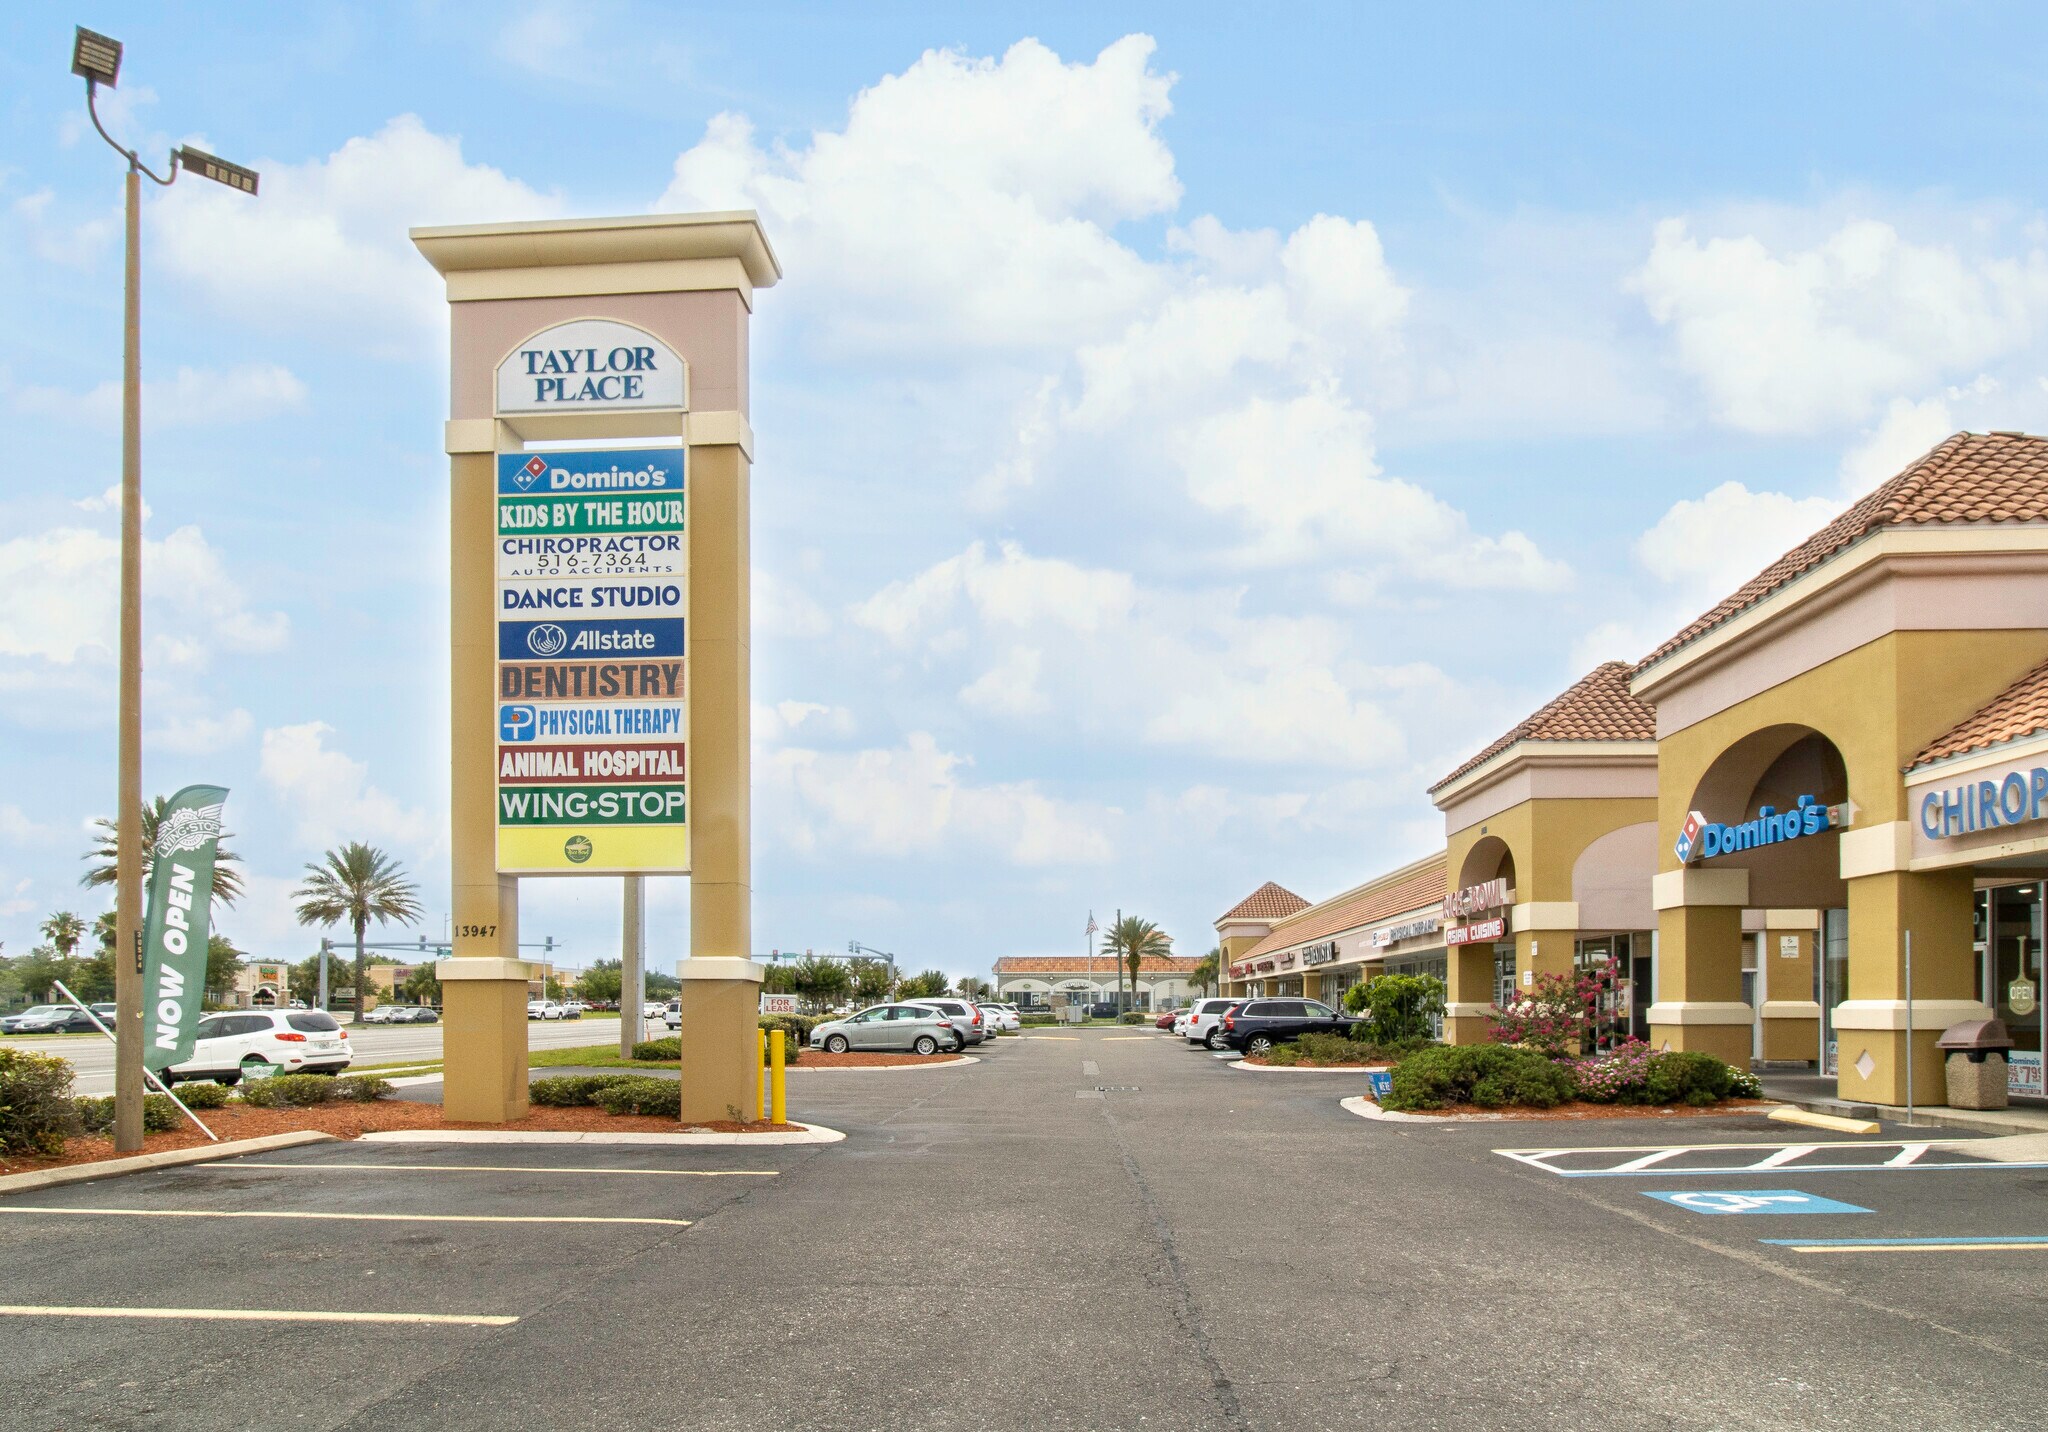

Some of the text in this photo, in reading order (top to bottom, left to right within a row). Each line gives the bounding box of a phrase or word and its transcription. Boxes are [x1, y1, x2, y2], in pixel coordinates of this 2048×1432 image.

[521, 347, 657, 375] TAYLOR
[534, 376, 644, 402] PLACE
[551, 464, 666, 489] Domino's
[500, 500, 684, 529] KIDS BY THE HOUR
[503, 535, 680, 556] CHIROPRACTOR
[511, 565, 673, 576] AUTO ACCIDENTS
[537, 553, 647, 567] 516-7364
[503, 585, 680, 609] DANCE STUDIO
[571, 629, 655, 651] Allstate
[502, 663, 681, 698] DENTISTRY
[539, 709, 612, 736] PHYSICAL
[616, 707, 681, 734] THERAPY
[500, 750, 683, 778] ANIMAL HOSPITAL
[1704, 794, 1829, 858] Domino's
[1471, 879, 1504, 912] BOWL
[454, 925, 497, 939] 13947
[1447, 920, 1502, 944] ASIAN CUISINE
[156, 863, 196, 1051] NOW OPEN
[770, 998, 790, 1006] FOR
[2010, 986, 2034, 1000] OPEN
